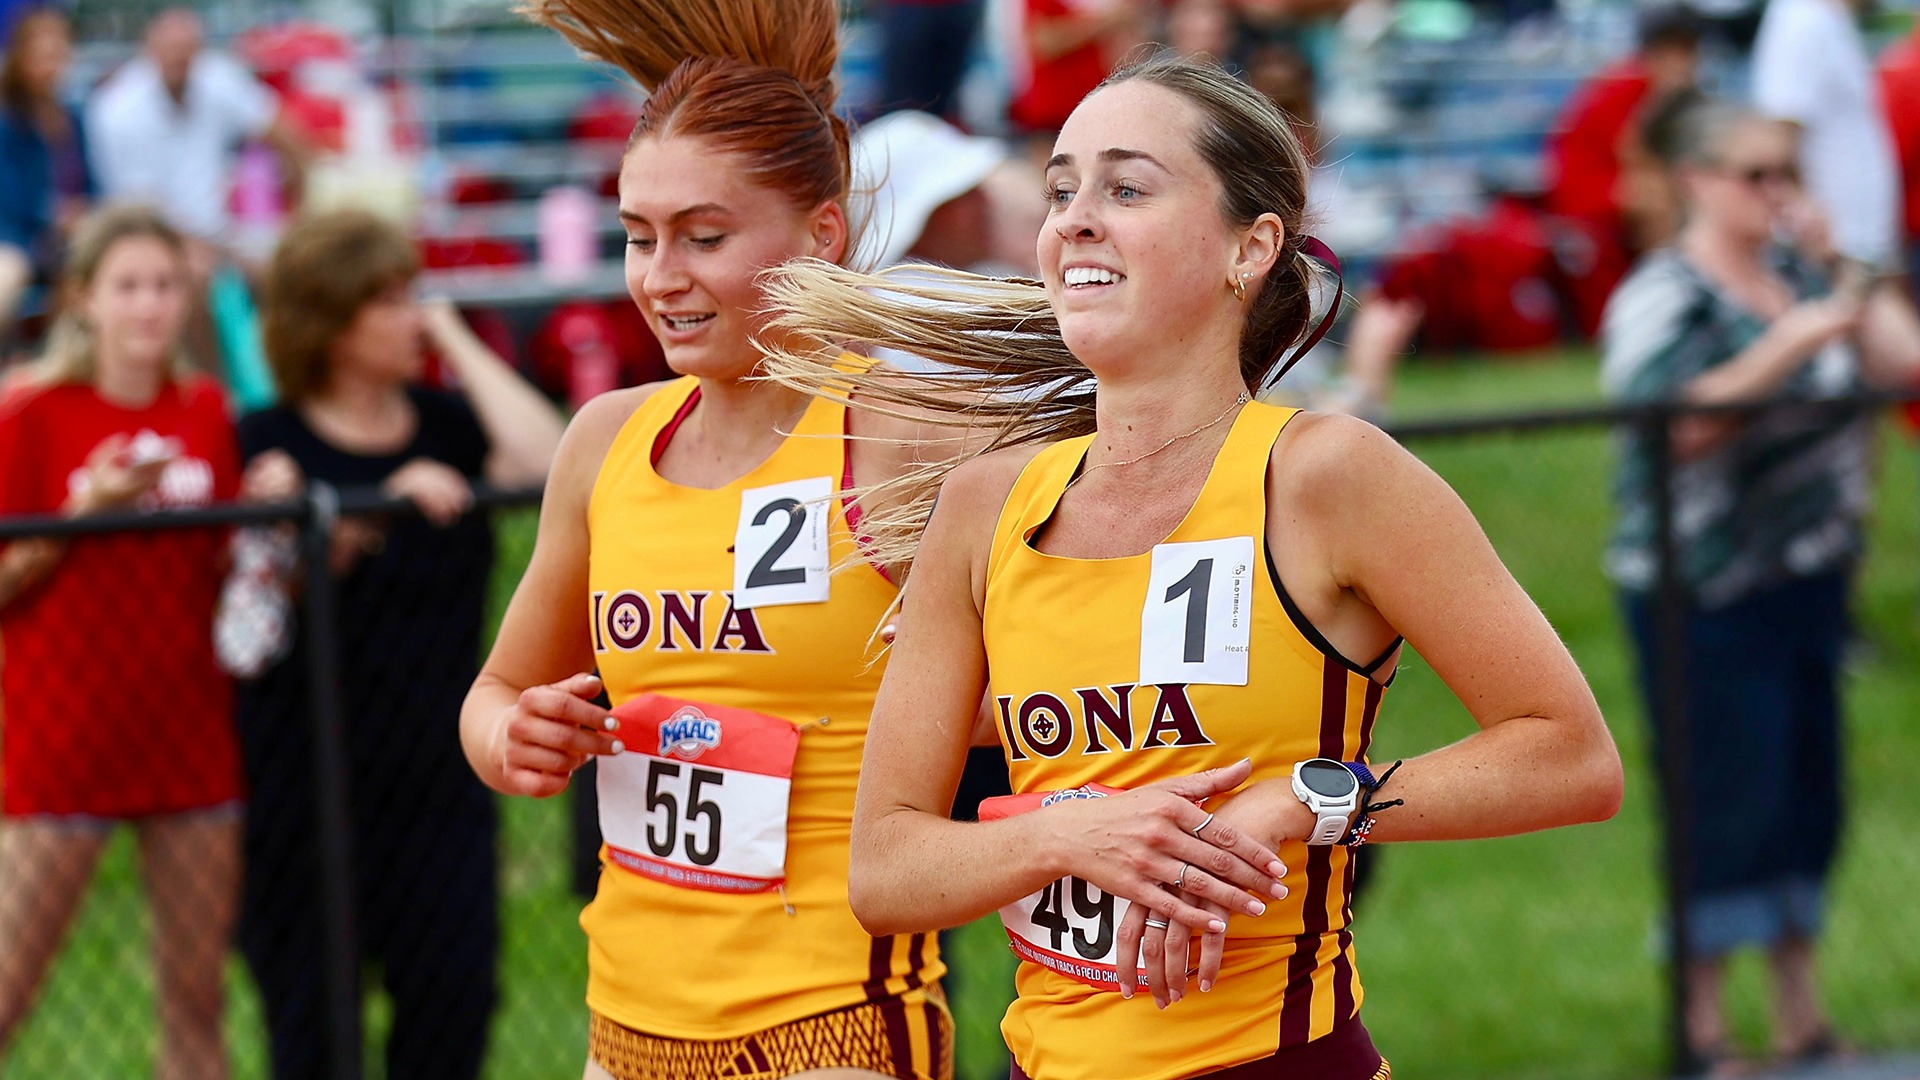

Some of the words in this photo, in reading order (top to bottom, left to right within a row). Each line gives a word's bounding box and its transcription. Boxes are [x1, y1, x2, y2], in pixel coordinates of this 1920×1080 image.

[746, 498, 806, 588] 2
[592, 590, 777, 654] IONA
[1164, 557, 1214, 664] 1
[1225, 645, 1244, 653] Heat
[661, 719, 716, 748] MAAC
[996, 682, 1216, 762] IONA
[646, 760, 723, 866] 55
[1031, 875, 1115, 959] 49
[1055, 959, 1075, 975] TRACK
[1075, 965, 1081, 976] &
[1081, 966, 1101, 981] FIELD
